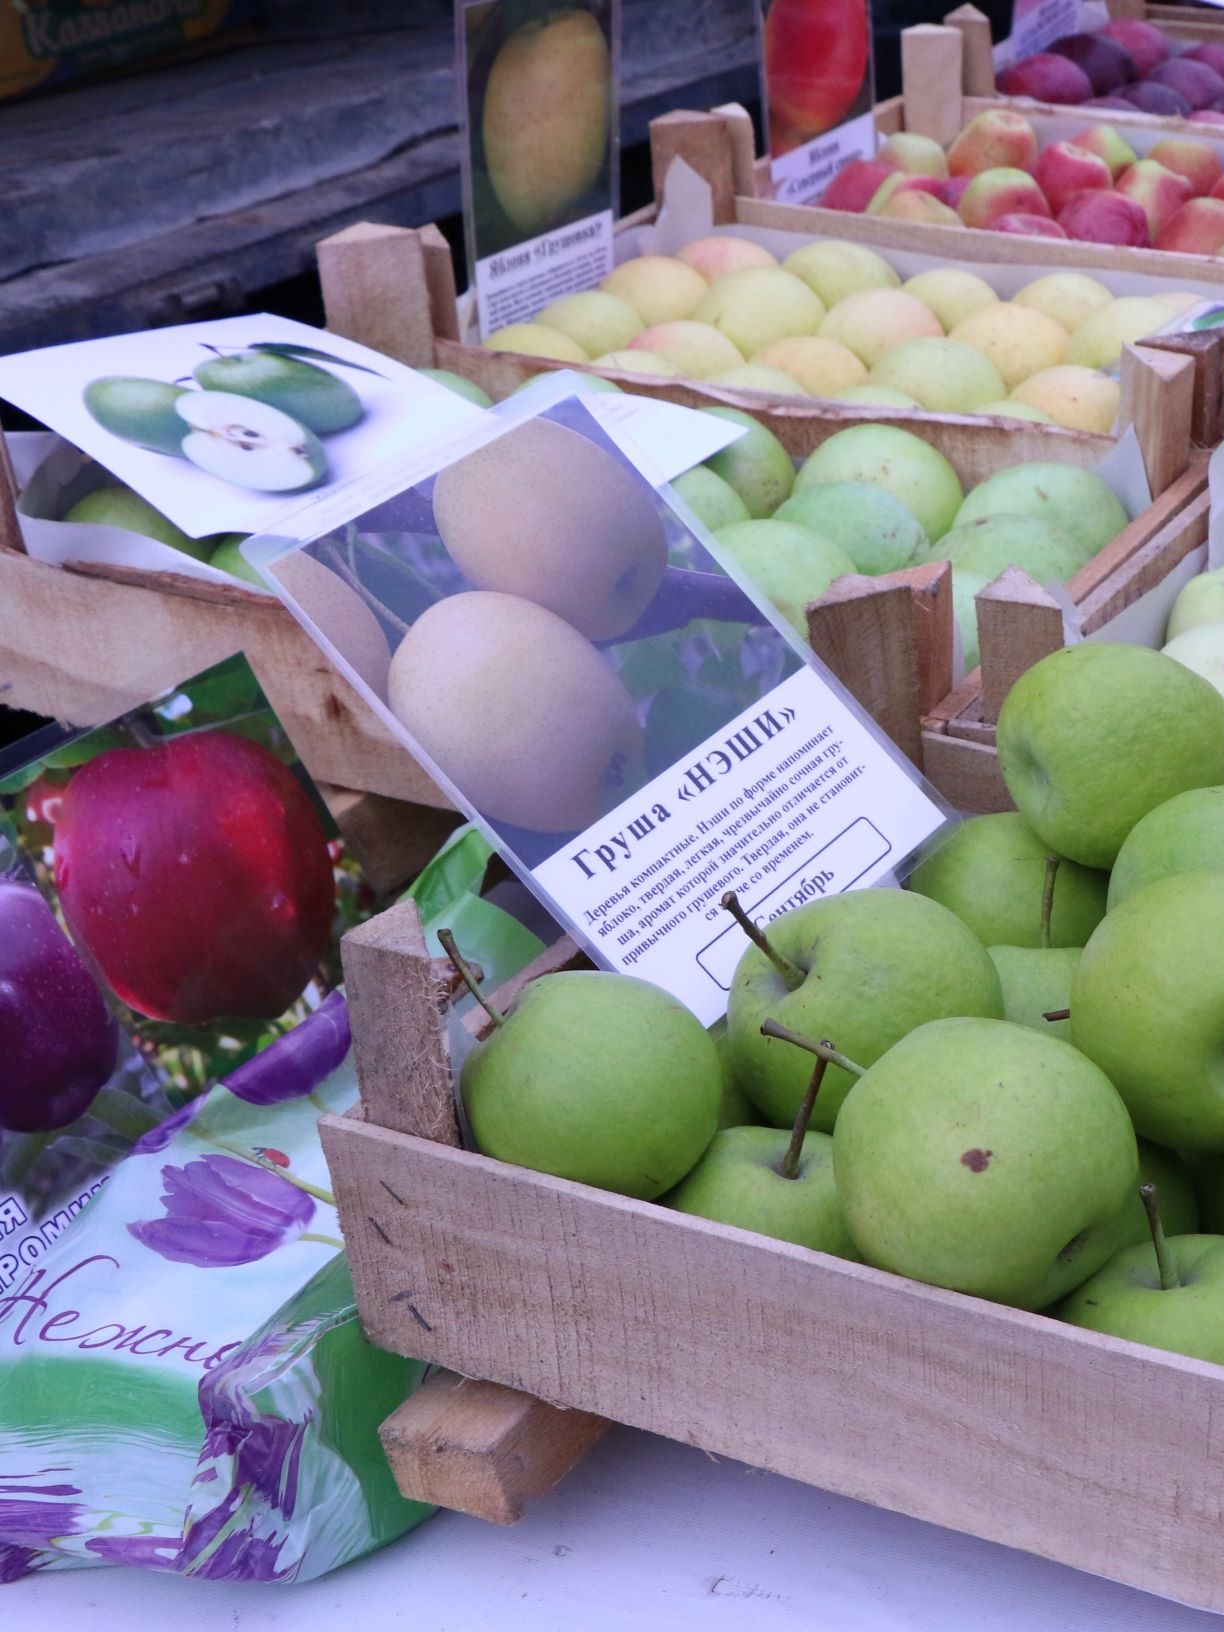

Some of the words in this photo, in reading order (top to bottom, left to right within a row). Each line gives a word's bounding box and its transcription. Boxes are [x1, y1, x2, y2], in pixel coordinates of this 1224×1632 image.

[569, 802, 672, 880] Груша
[676, 706, 796, 802] «НЭШИ»
[582, 884, 631, 926] Деревья
[628, 833, 699, 889] компактные.
[695, 806, 730, 835] Нэши
[728, 796, 744, 811] по
[742, 770, 777, 800] форме
[774, 725, 833, 774] напоминает
[596, 903, 641, 937] яблоко,
[637, 867, 686, 904] твердая,
[684, 836, 724, 870] легкая,
[721, 782, 789, 836] чрезвычайно
[787, 754, 824, 785] сочная
[821, 739, 843, 758] гру-
[615, 927, 640, 946] ша,
[637, 895, 676, 929] аромат
[674, 859, 720, 899] которой
[718, 809, 782, 863] значительно
[781, 765, 837, 813] отличается
[835, 755, 848, 769] от
[620, 910, 687, 966] привычного
[685, 866, 744, 913] грушевого.
[739, 829, 790, 865] Твердая,
[786, 812, 807, 830] она
[805, 801, 820, 815] не
[818, 764, 866, 804] становит-
[703, 906, 719, 921] ся
[748, 870, 763, 884] со
[760, 830, 814, 874] временем.
